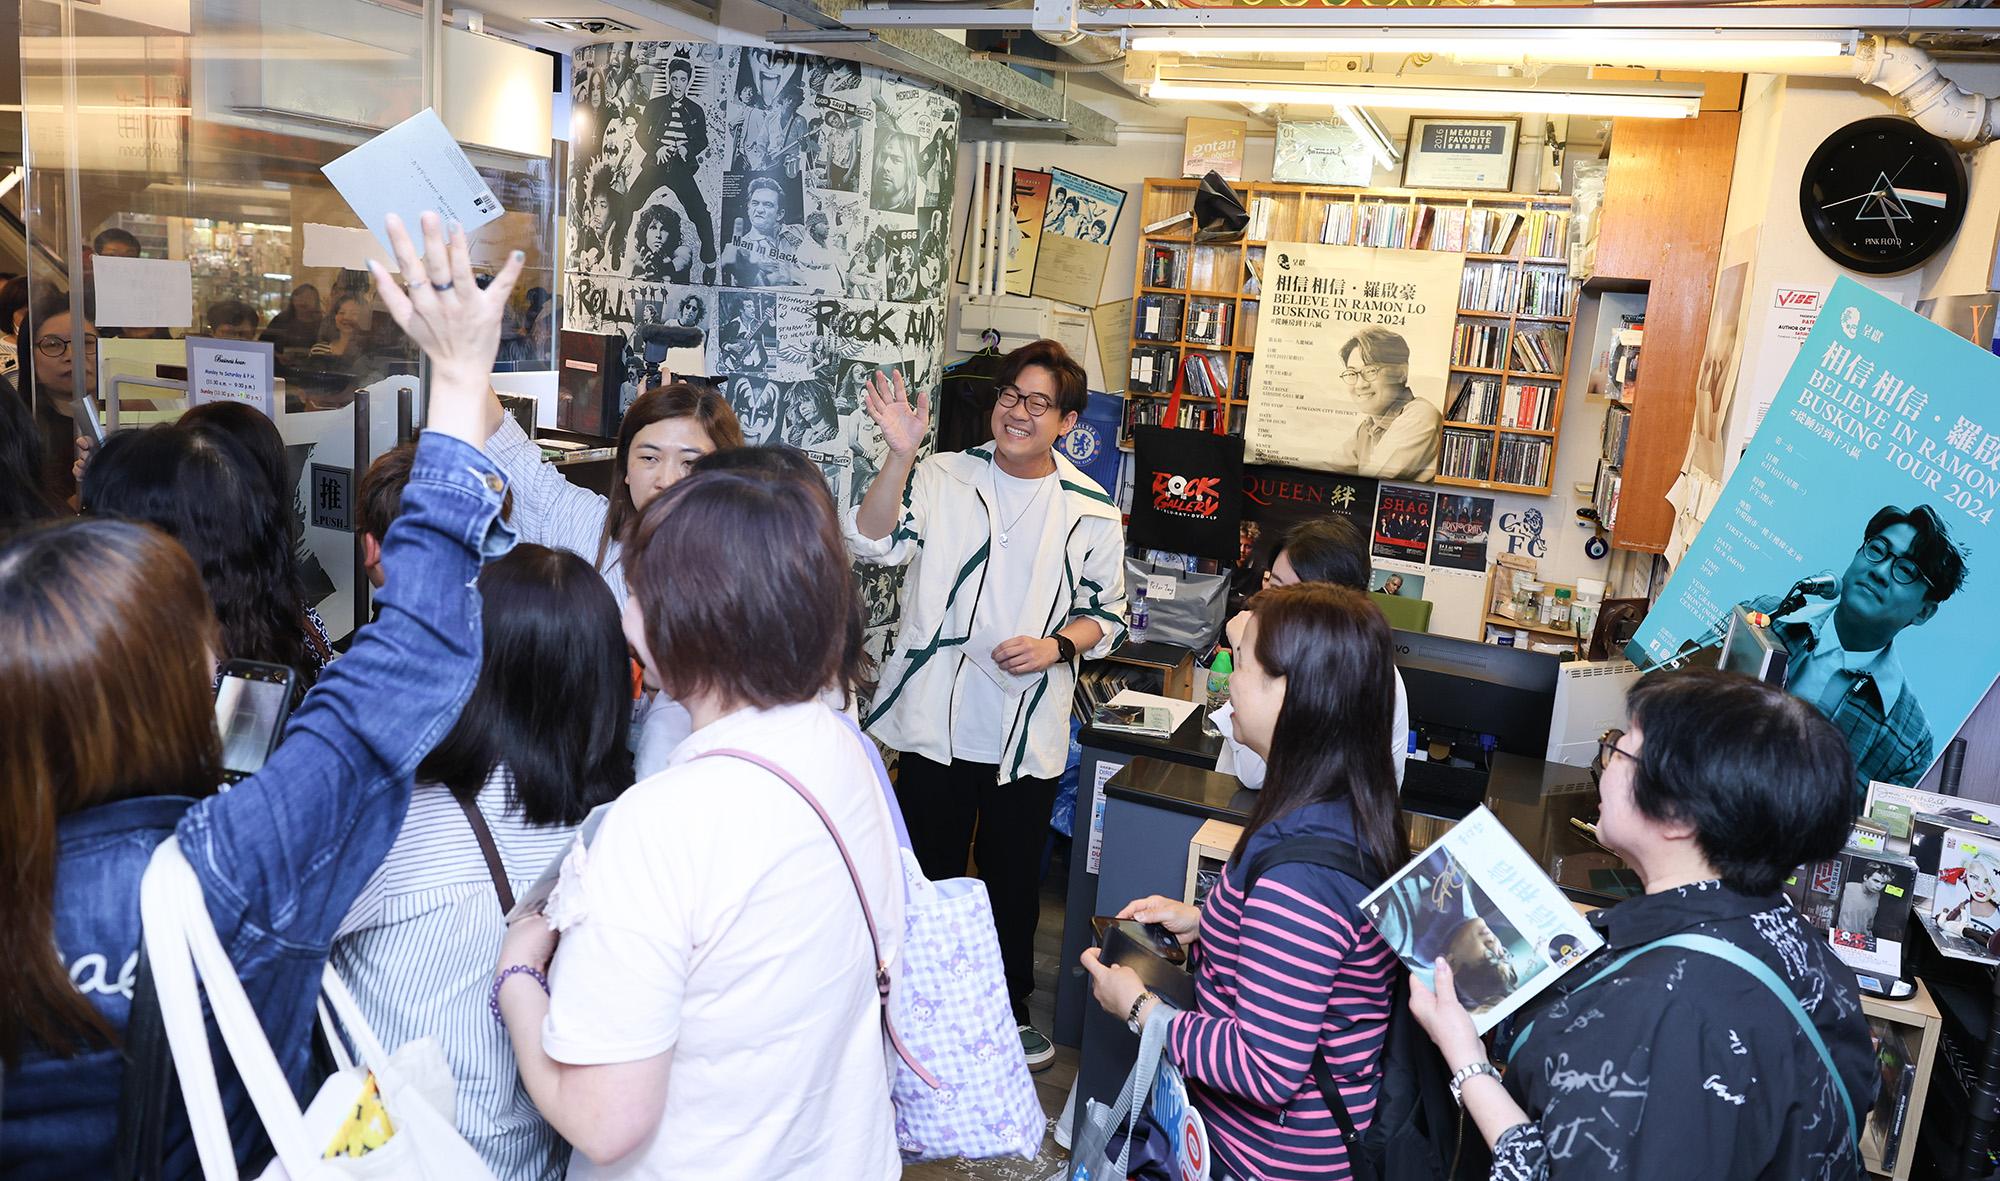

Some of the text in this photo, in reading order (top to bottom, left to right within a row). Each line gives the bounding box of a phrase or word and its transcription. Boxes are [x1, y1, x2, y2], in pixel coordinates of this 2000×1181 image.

[831, 100, 846, 111] SAVE
[896, 90, 919, 101] MERCURY
[1192, 138, 1236, 158] gotan
[1434, 129, 1444, 149] 2016
[1448, 136, 1491, 144] FAVORITE
[901, 231, 917, 240] 666
[1880, 237, 1902, 246] FLOYD
[733, 235, 754, 251] Man
[769, 248, 798, 264] Black
[1276, 274, 1309, 292] 相信
[1312, 277, 1345, 295] 相信
[576, 279, 634, 324] ROLL
[1274, 293, 1426, 314] BELIEVE IN RAMON LO
[816, 299, 900, 346] ROCK
[905, 306, 935, 346] AND
[1272, 306, 1406, 326] BUSKING TOUR 2024
[790, 330, 815, 339] HEAVEN
[1821, 340, 1875, 390] 相信
[1871, 370, 1928, 422] 相信
[1808, 369, 1890, 429] BELIEVE
[1890, 420, 1918, 446] IN
[1917, 437, 2000, 499] RAMON
[1797, 388, 1882, 450] BUSKING
[1885, 442, 1942, 492] TOUR
[1943, 484, 1995, 526] 2024
[320, 476, 342, 510] 推
[1152, 471, 1221, 498] ROCK
[1240, 475, 1325, 505] QUEEN
[1153, 496, 1219, 516] GALLERY
[1330, 485, 1356, 509] 絆
[1381, 497, 1429, 515] SHAG
[320, 516, 343, 528] PUSH
[1716, 537, 1734, 551] DATE
[1725, 522, 1760, 551] FIRST STOP
[1705, 558, 1720, 573] TIME
[1692, 578, 1712, 596] VENUE
[1679, 597, 1705, 621] CENTRAL
[1830, 860, 1840, 894] KERSHAW
